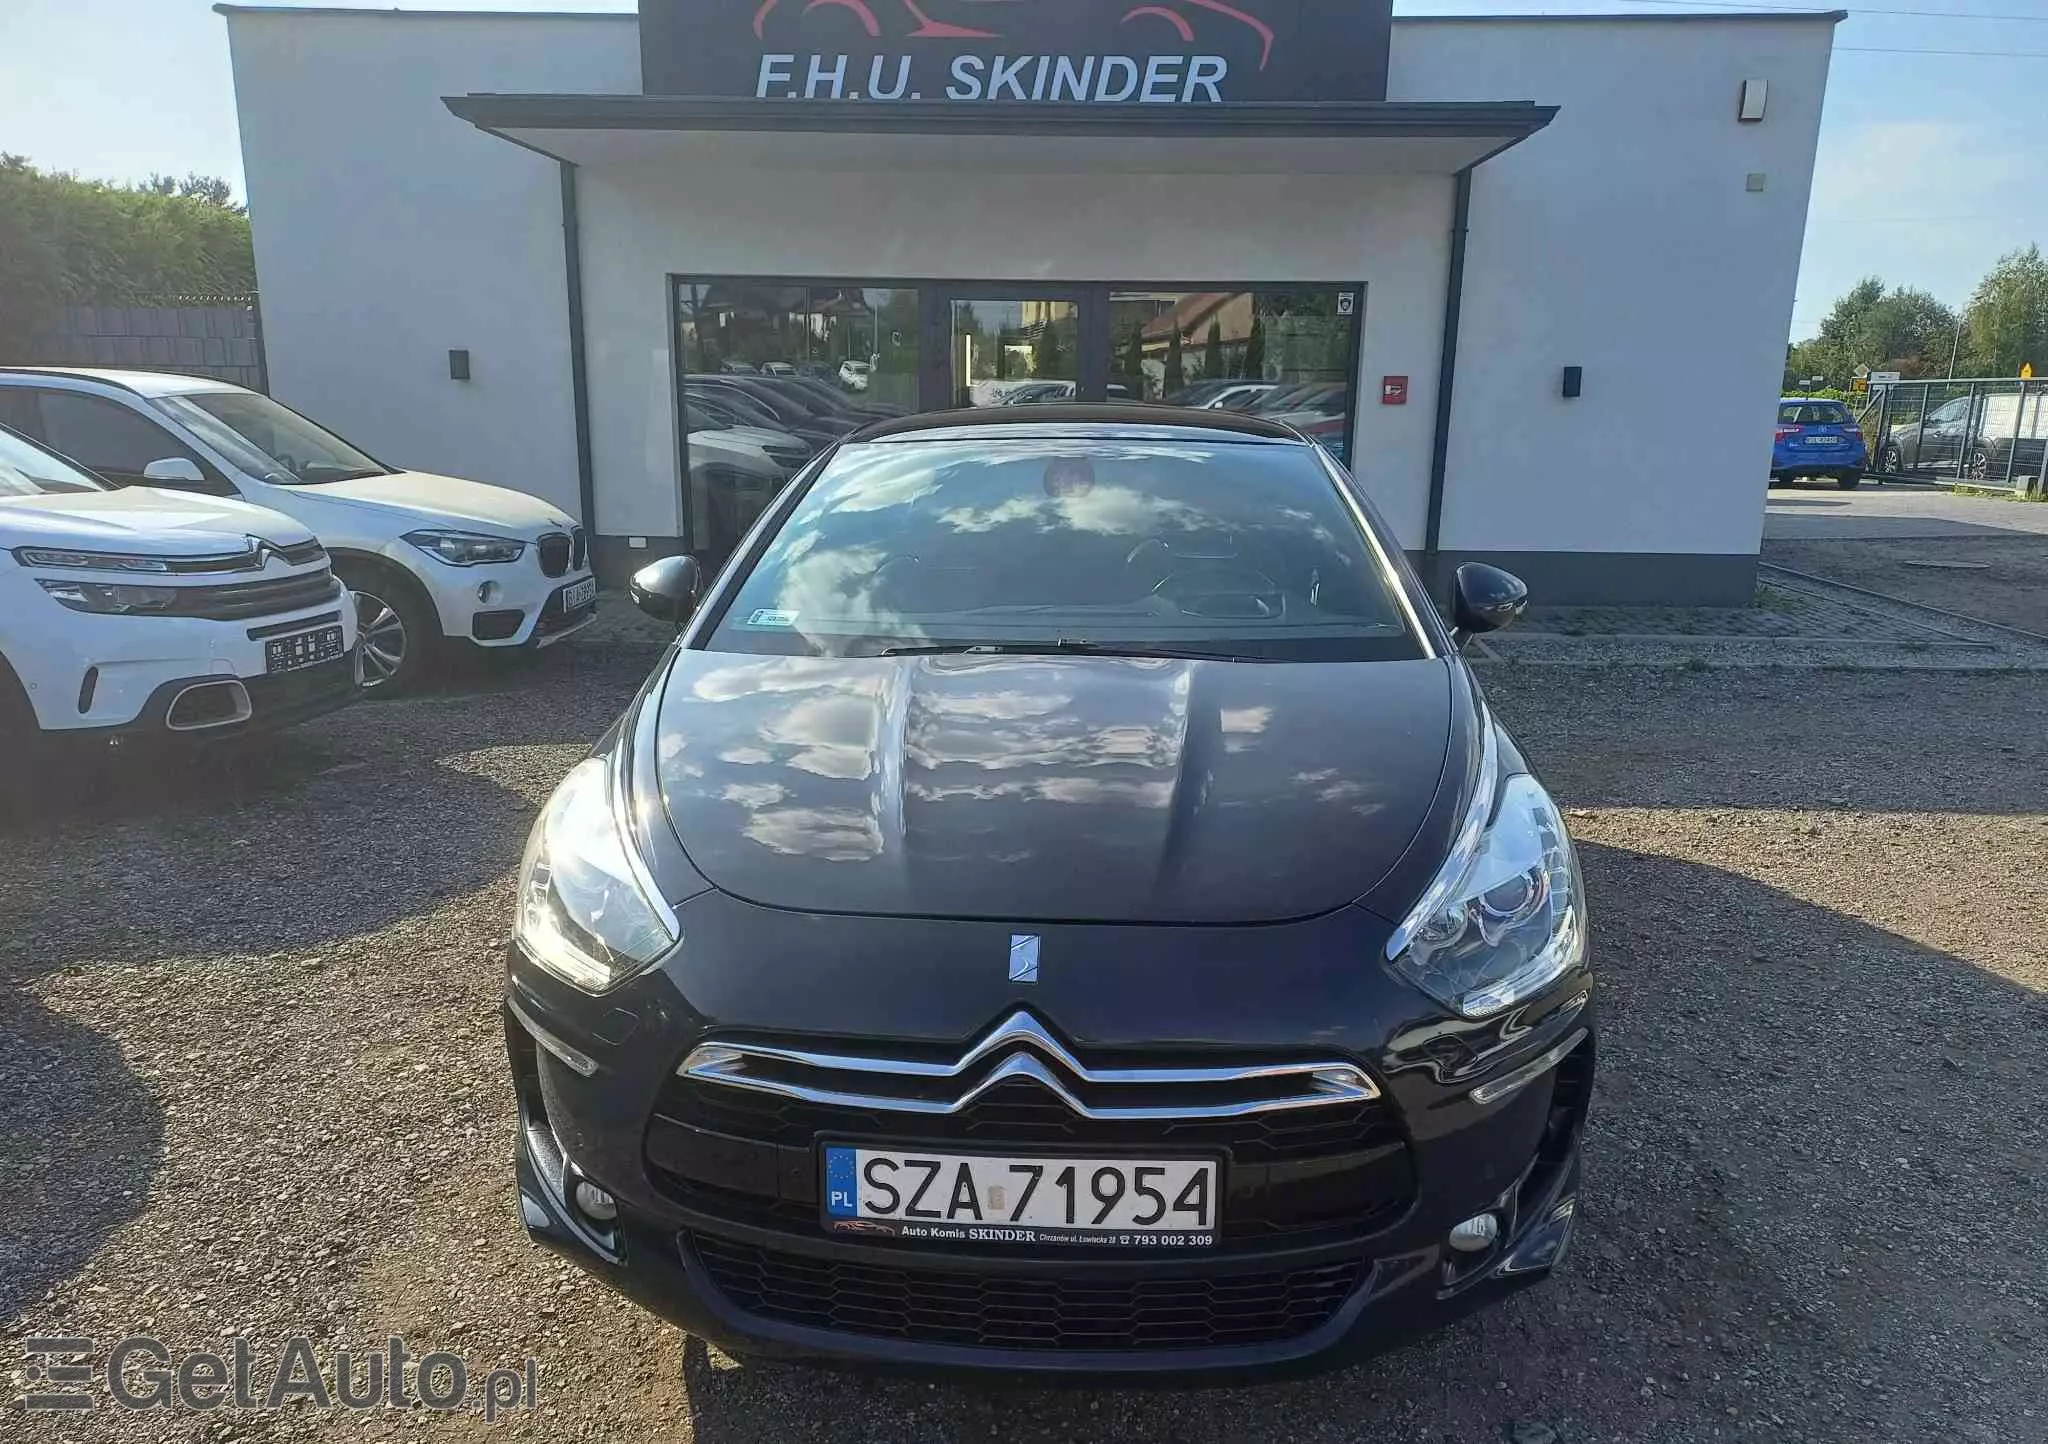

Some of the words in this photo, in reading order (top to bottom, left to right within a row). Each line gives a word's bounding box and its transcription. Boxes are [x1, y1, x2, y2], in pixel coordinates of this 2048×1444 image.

[756, 54, 921, 100] F.H.U.
[945, 54, 1228, 102] SKINDER
[831, 1191, 853, 1208] PL
[863, 1157, 984, 1221] SZA
[1008, 1164, 1209, 1226] 71954
[902, 1226, 928, 1237] Auto
[930, 1227, 966, 1239] Komis
[968, 1228, 1036, 1242] SKINDER
[1133, 1235, 1157, 1246] 793
[1161, 1235, 1185, 1246] 002
[1188, 1236, 1213, 1246] 309
